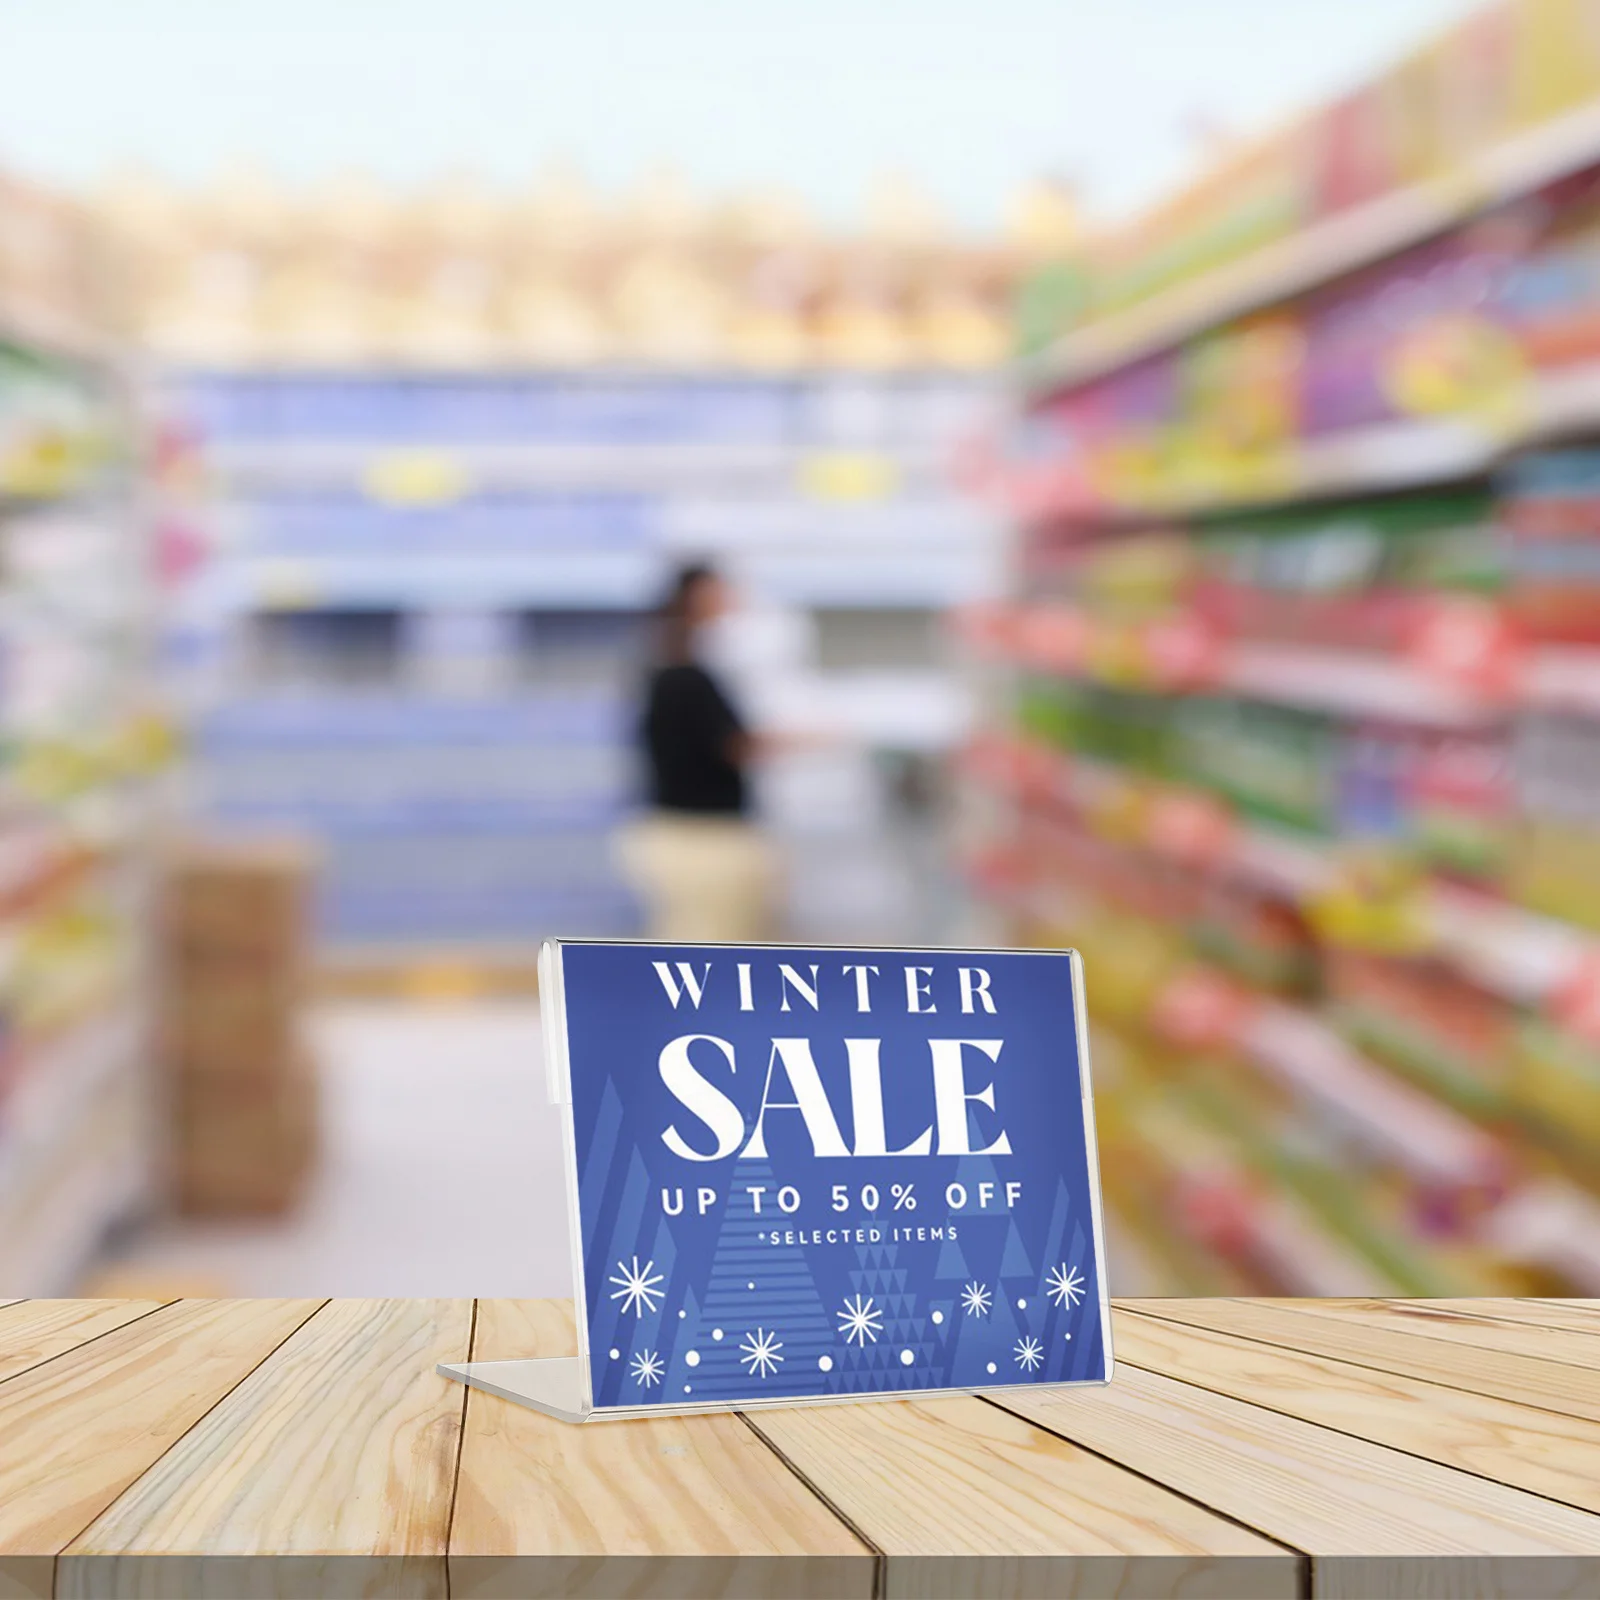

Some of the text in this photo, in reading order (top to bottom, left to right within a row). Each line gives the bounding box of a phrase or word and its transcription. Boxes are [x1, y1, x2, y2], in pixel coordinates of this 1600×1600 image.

[651, 961, 998, 1014] WINTER
[658, 1034, 1013, 1162] SALE
[661, 1181, 1022, 1215] UP TO 50% OFF
[893, 1226, 959, 1242] ITEMS
